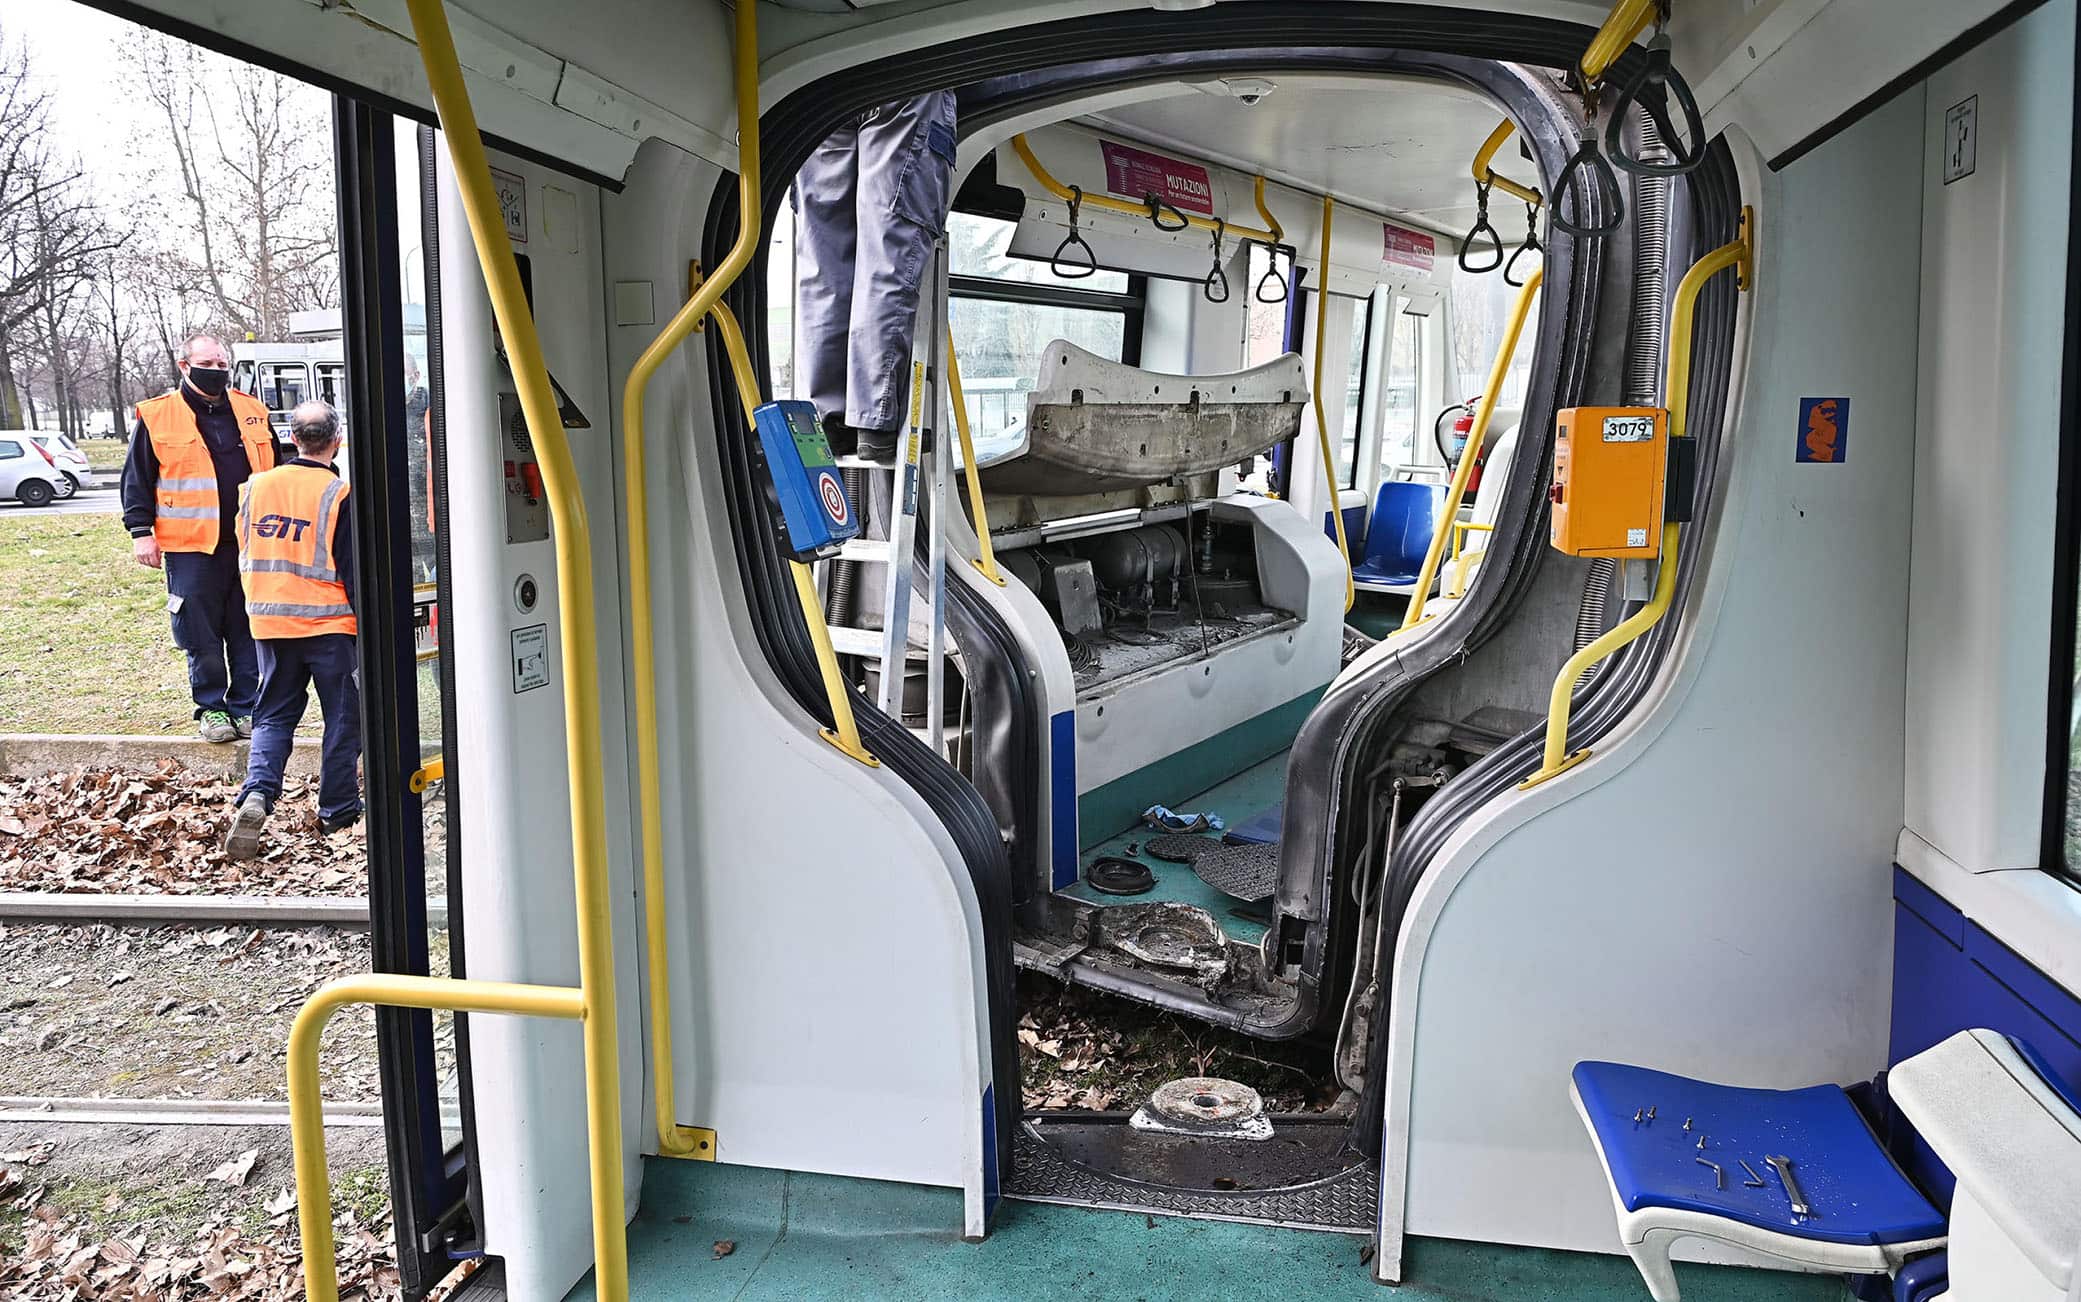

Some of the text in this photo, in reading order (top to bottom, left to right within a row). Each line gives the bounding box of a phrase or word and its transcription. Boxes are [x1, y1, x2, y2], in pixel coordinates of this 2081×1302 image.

[1166, 174, 1209, 197] MUTAZIONI
[246, 416, 264, 425] GTT
[278, 430, 291, 438] GT
[1609, 423, 1646, 436] 3079
[252, 514, 311, 542] GTT
